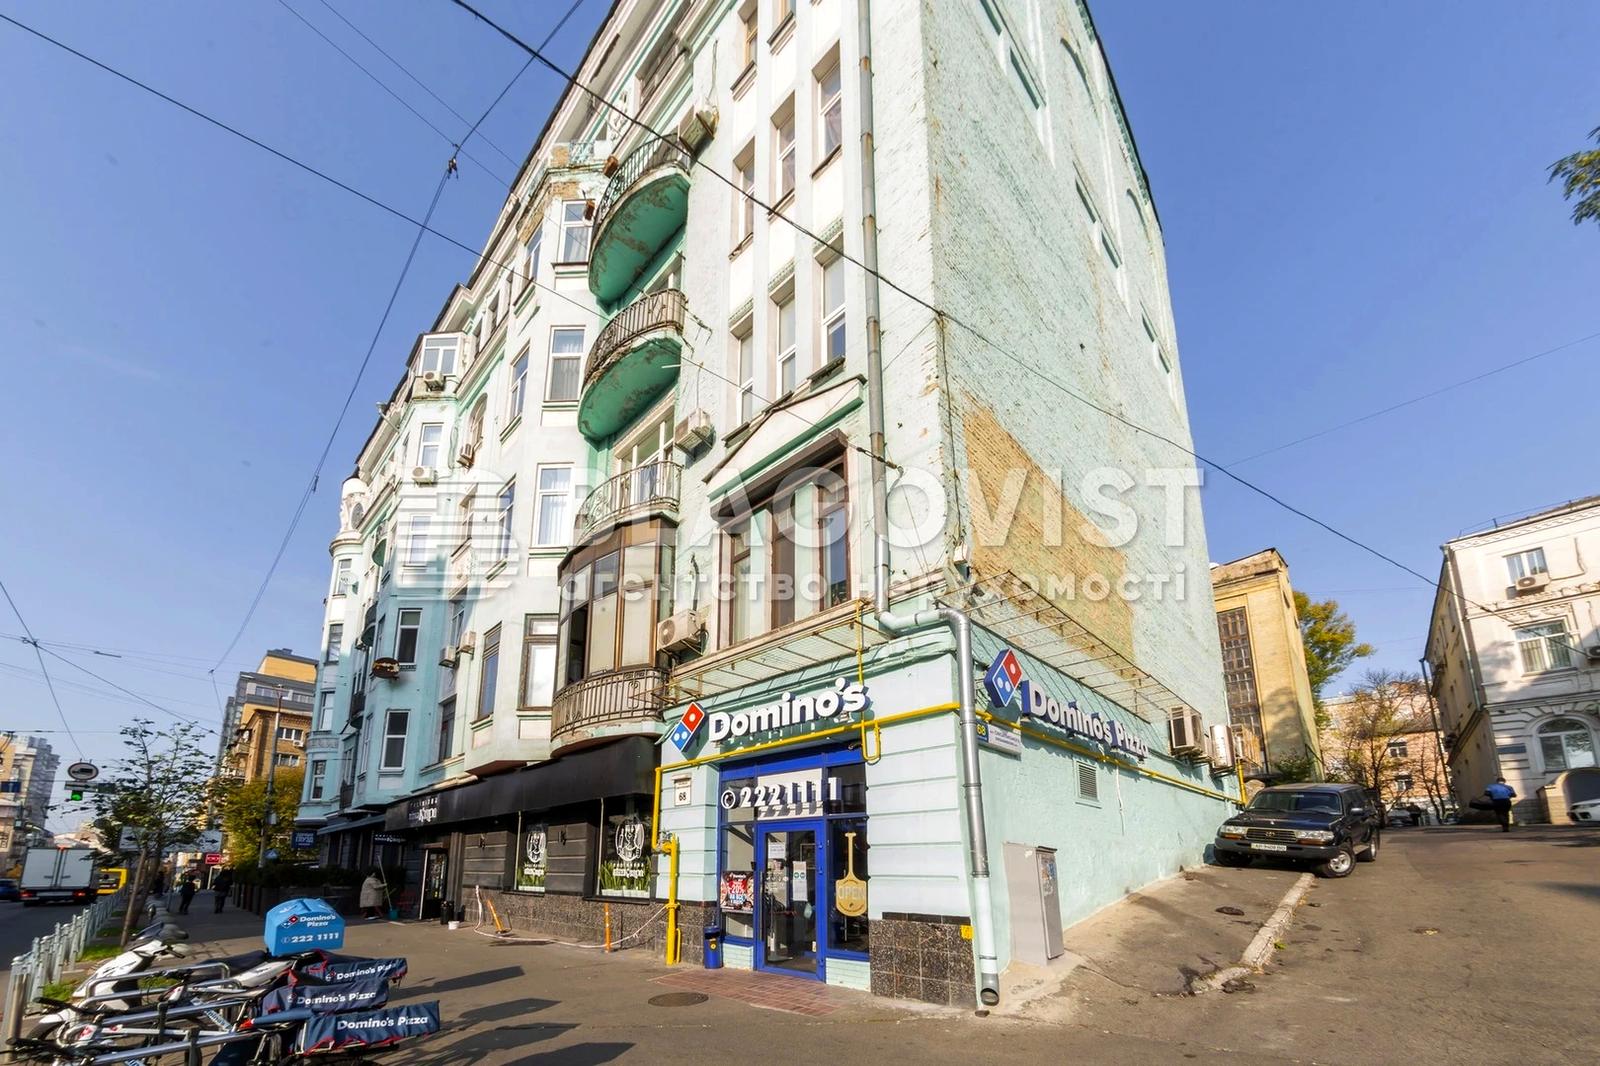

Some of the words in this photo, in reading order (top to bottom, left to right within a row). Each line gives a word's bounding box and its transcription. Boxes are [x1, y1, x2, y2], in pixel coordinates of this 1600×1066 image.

[708, 677, 868, 742] Domino's
[1021, 679, 1114, 746] Domino's
[1110, 720, 1149, 758] Pizza
[976, 723, 986, 736] 68
[678, 791, 687, 802] 68
[300, 914, 336, 922] Domino's
[291, 935, 314, 943] 222
[317, 932, 339, 941] 1111
[336, 967, 376, 980] Domino's
[296, 993, 346, 1005] Domino's
[350, 991, 376, 1000] Pizza
[337, 1017, 394, 1030] Domino's
[398, 1016, 429, 1025] Pizza
